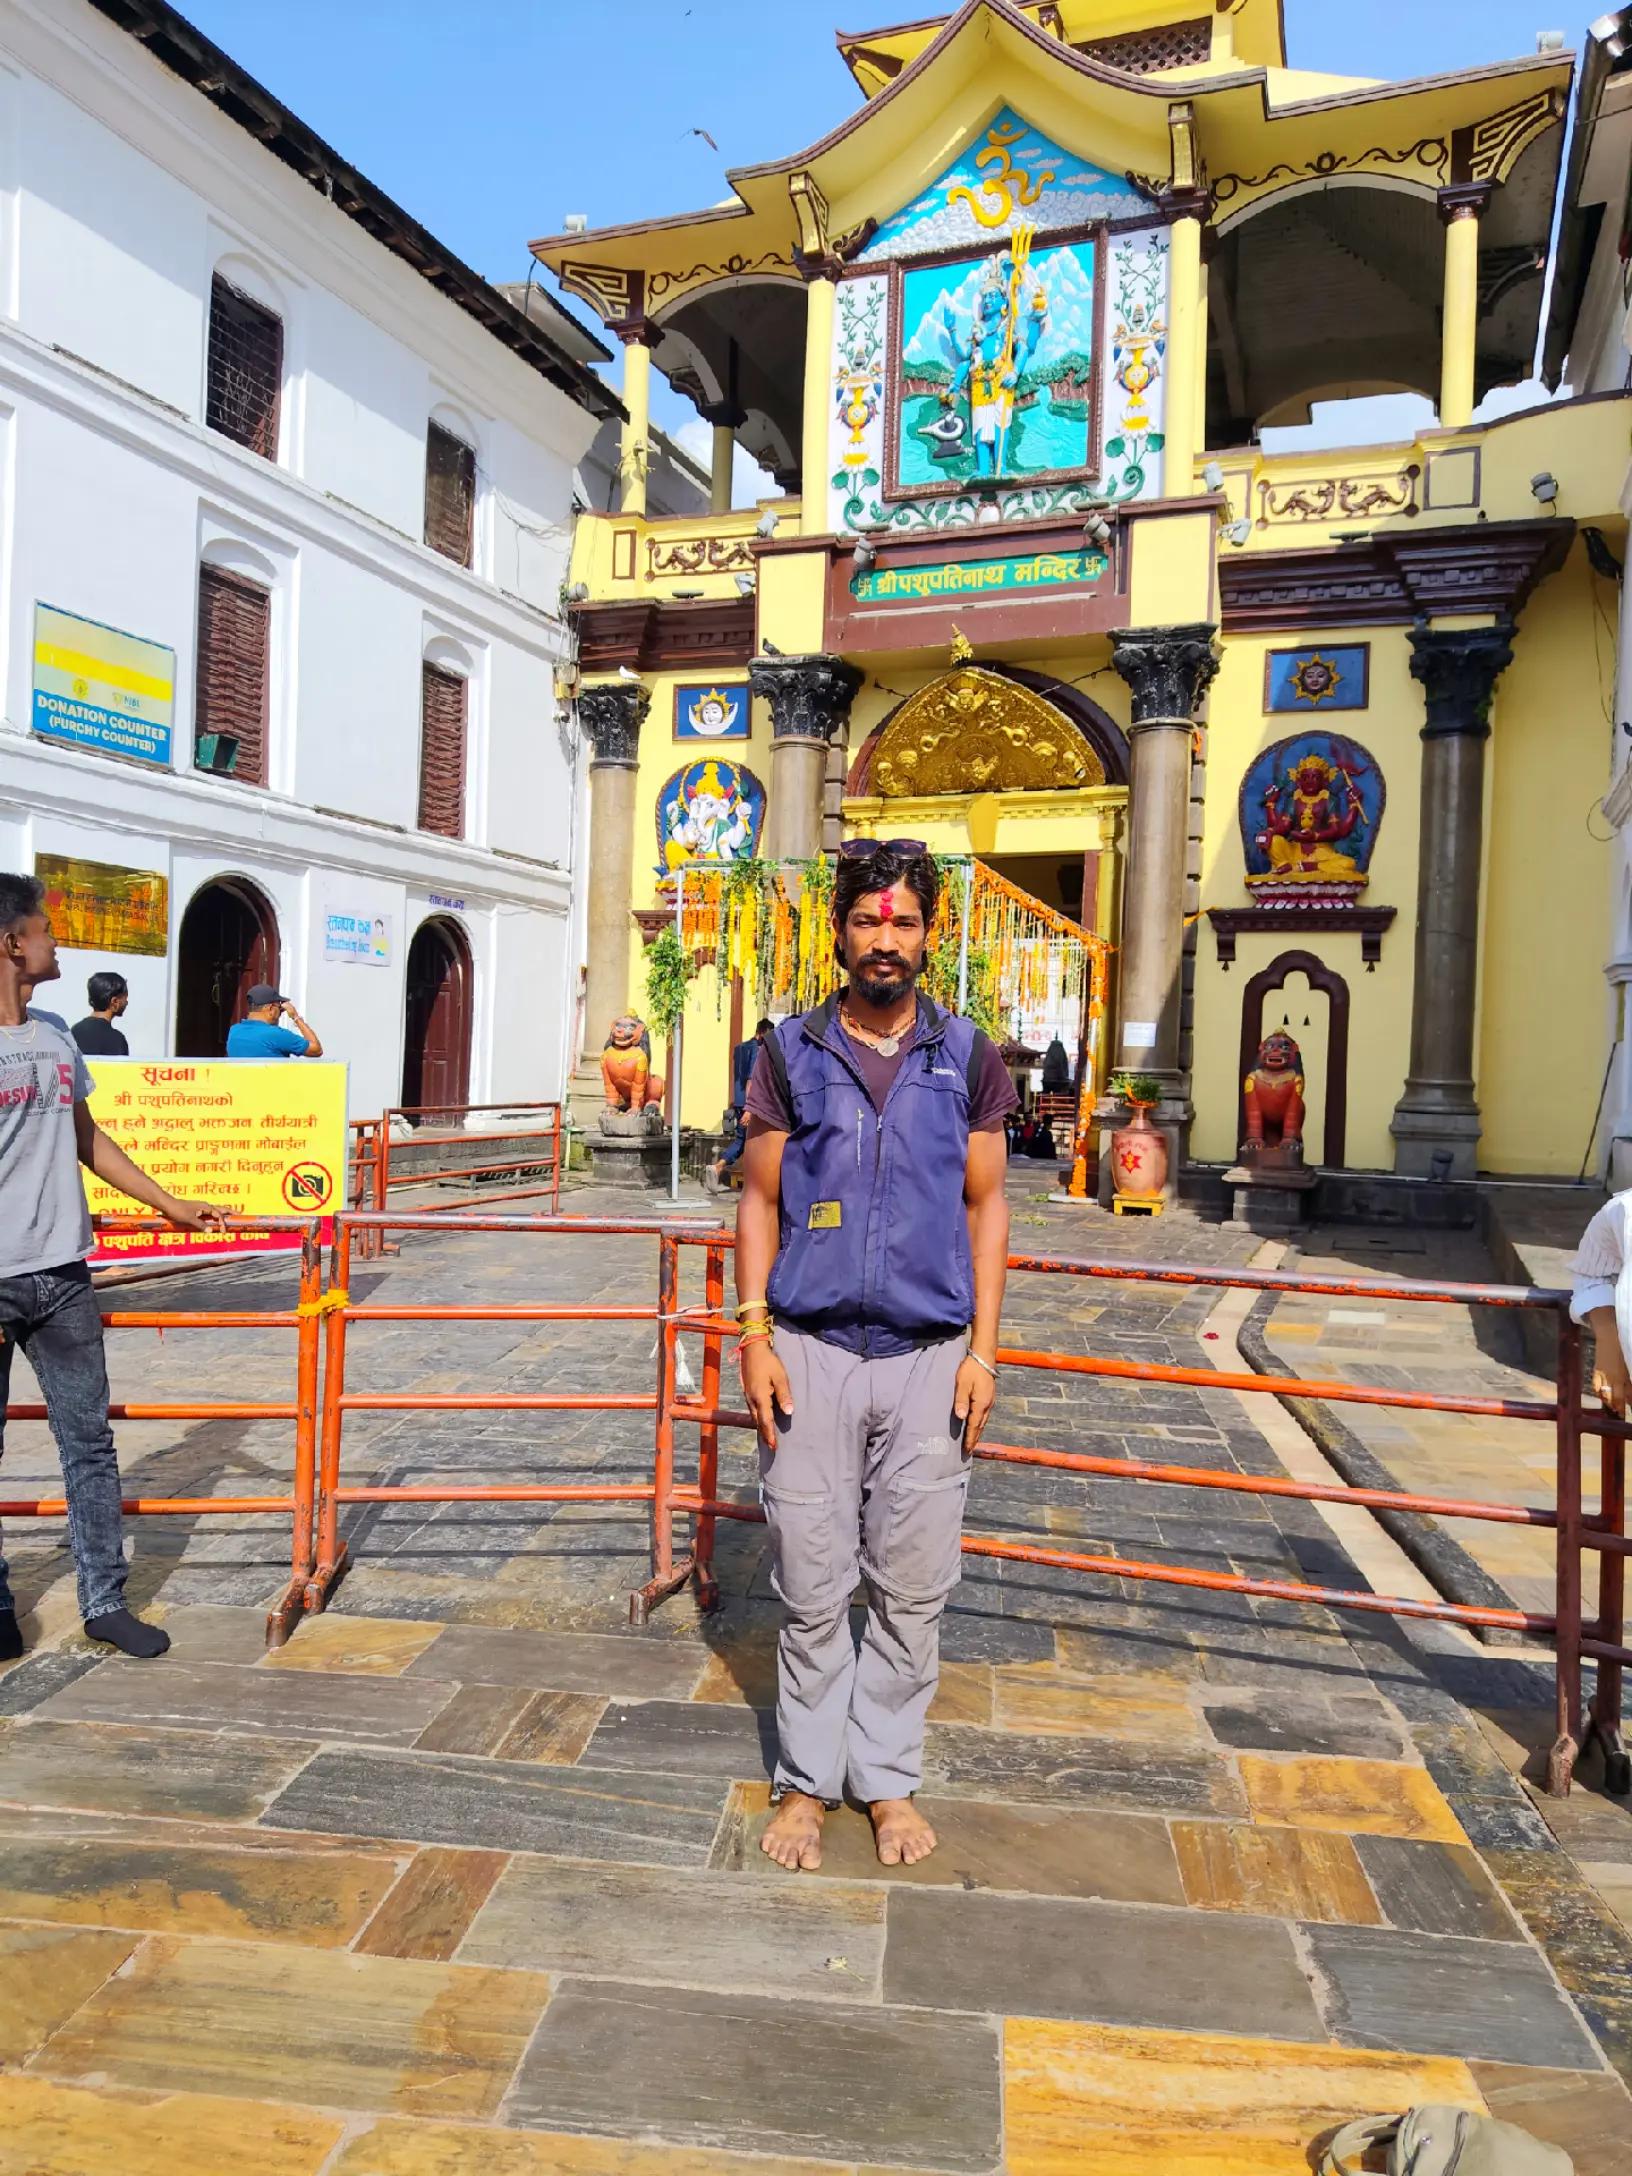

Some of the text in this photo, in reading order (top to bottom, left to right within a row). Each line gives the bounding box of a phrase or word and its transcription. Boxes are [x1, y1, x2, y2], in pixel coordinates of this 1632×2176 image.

[37, 694, 166, 741] DONATION COUNTER
[102, 730, 156, 754] COUNTER)
[140, 1067, 195, 1086] सूचना
